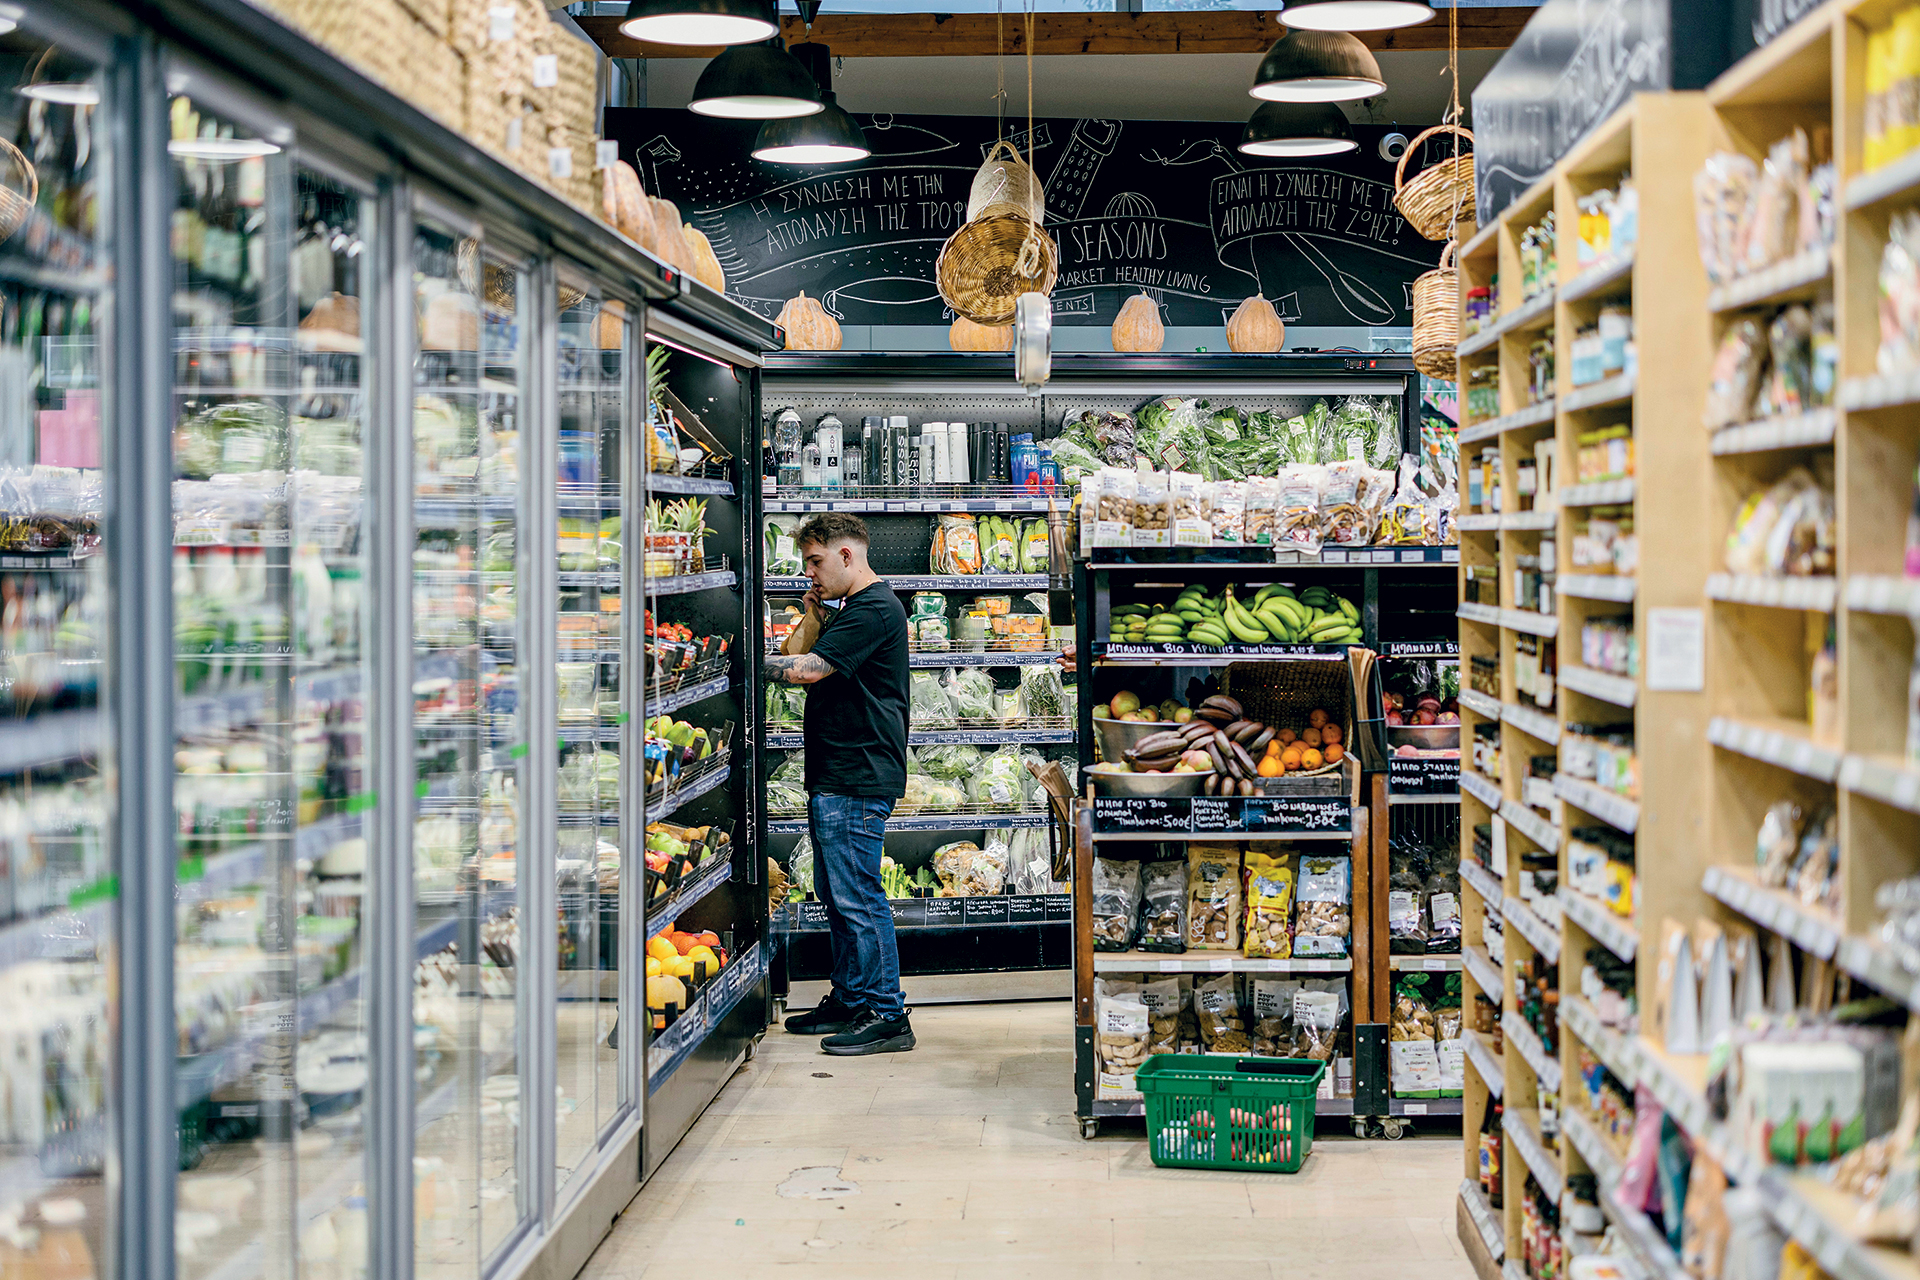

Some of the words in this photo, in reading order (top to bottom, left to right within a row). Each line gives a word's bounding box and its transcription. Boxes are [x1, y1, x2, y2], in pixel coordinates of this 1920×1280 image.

[750, 199, 771, 222] Η
[779, 176, 871, 213] ΣΥΝΔΕΣΗ
[914, 174, 943, 196] ΤΗΝ
[1218, 176, 1251, 204] ΕΙΝΑΙ
[1275, 173, 1343, 200] ΣΥΝΔΕΣΗ
[1351, 180, 1373, 208] ΜΕ
[766, 207, 866, 254] ΑΠΟΛΑΥΣΗ
[874, 202, 910, 231] ΤΗΣ
[1219, 200, 1298, 238] ΑΠΟΛΑΥΣΗ
[1305, 200, 1339, 231] ΤΗΣ
[1071, 221, 1167, 263] SEASONS
[1115, 266, 1164, 286] HEALTHY
[1166, 270, 1211, 294] LIVING
[1023, 454, 1038, 466] FIJI
